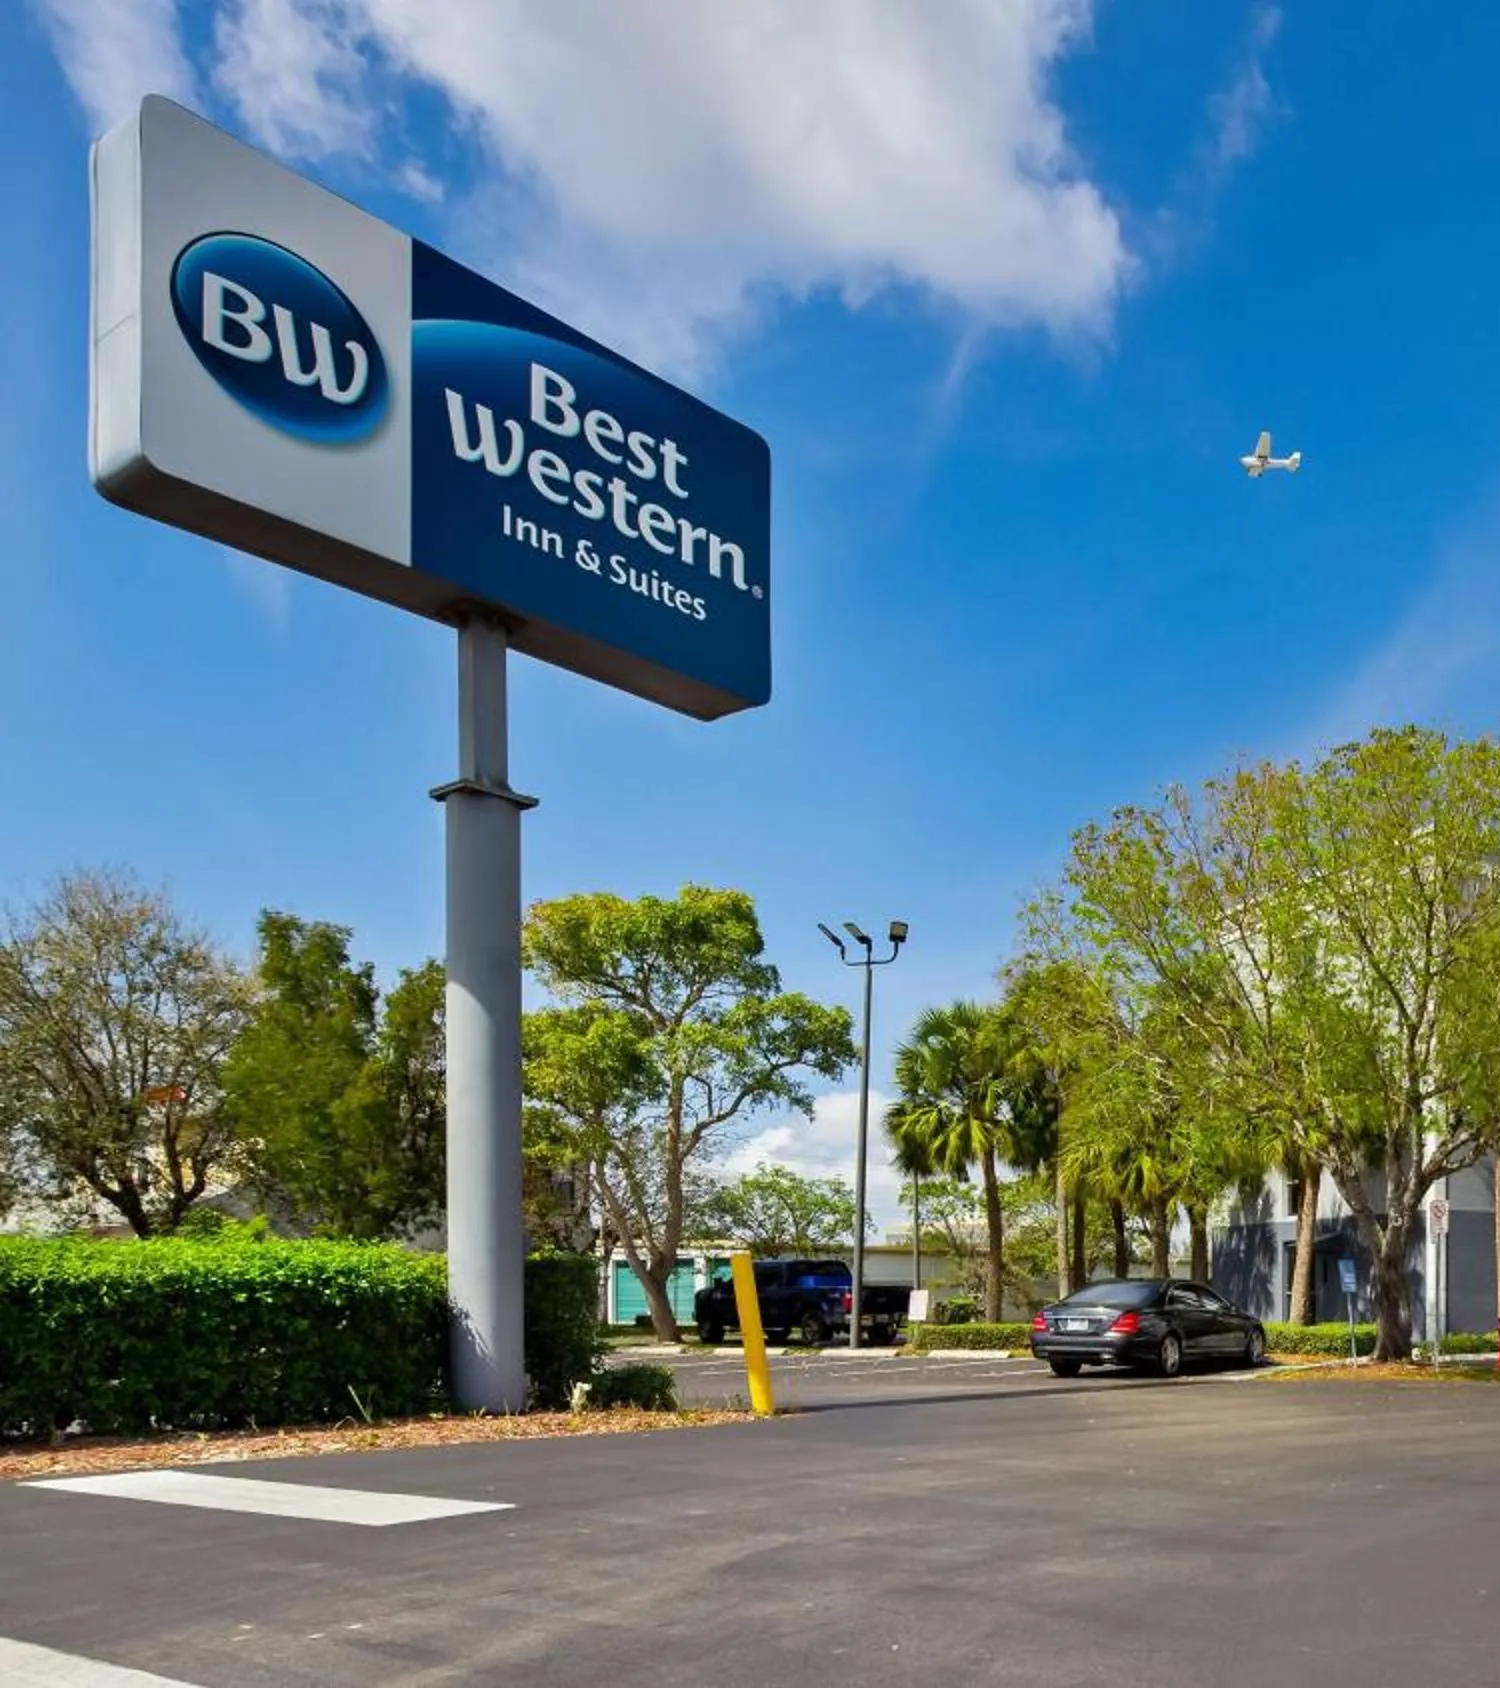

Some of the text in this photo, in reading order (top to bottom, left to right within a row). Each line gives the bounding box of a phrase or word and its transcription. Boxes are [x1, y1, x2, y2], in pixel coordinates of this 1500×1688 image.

[202, 271, 368, 404] BW
[530, 363, 689, 497] Best
[503, 505, 707, 621] Inn & Suites
